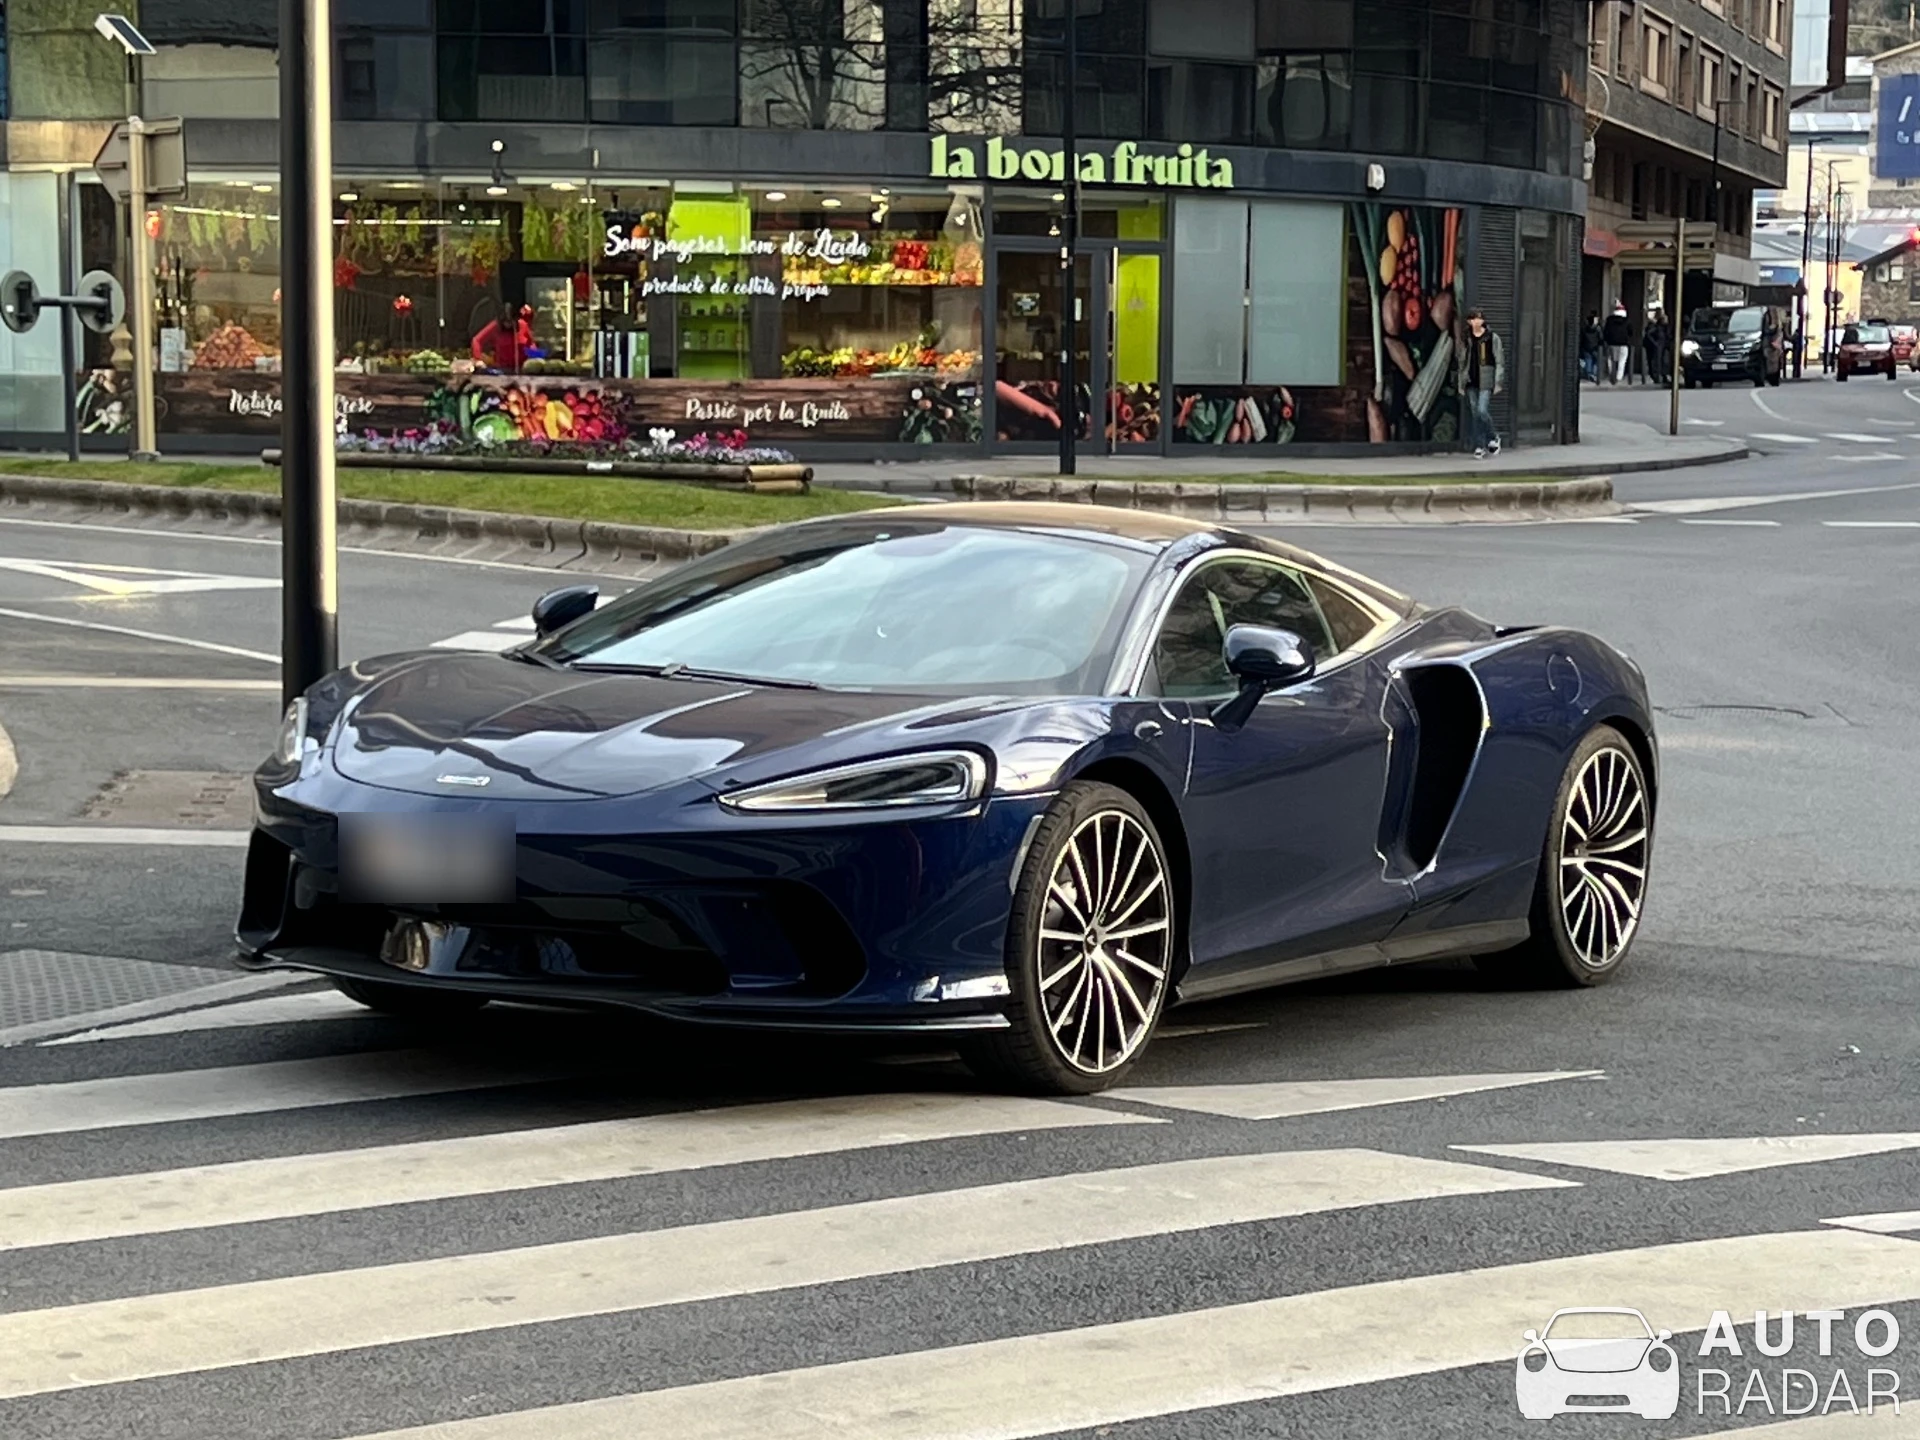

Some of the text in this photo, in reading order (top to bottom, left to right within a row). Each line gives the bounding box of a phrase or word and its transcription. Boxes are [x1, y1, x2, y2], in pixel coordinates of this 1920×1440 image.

[930, 134, 976, 178] la
[1111, 141, 1234, 187] fruita
[604, 225, 651, 256] Som
[738, 236, 778, 254] som
[782, 232, 807, 255] de
[807, 228, 871, 264] Lleida
[642, 275, 706, 297] producte
[710, 276, 730, 294] de
[742, 403, 774, 427] per
[779, 400, 797, 421] la
[796, 402, 851, 427] fruita
